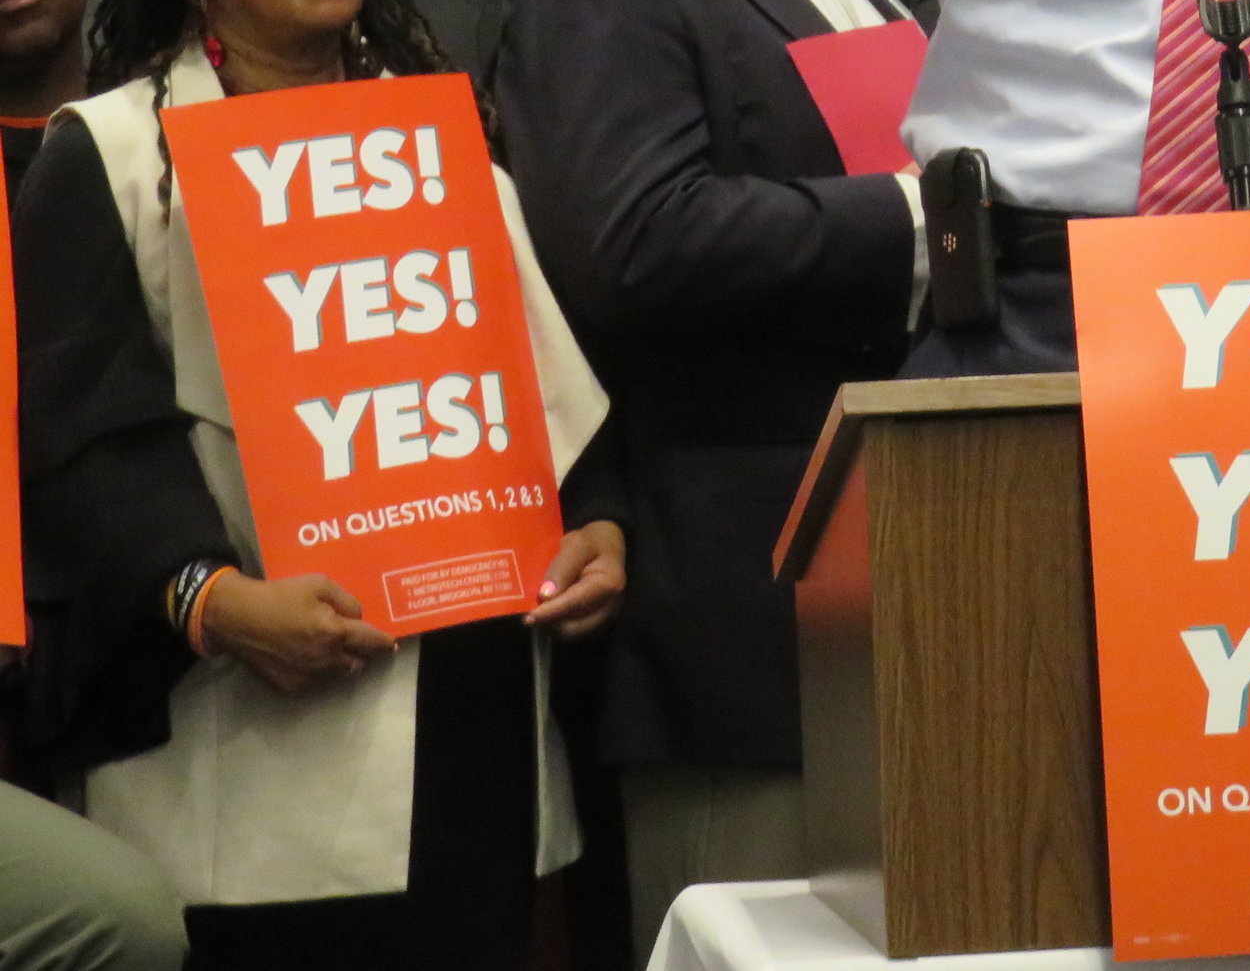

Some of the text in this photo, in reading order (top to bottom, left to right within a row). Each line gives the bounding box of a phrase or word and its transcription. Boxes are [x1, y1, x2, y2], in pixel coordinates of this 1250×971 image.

[232, 126, 446, 227] YES!
[264, 248, 478, 353] YES!
[294, 372, 509, 482] YES!
[298, 517, 341, 547] ON
[346, 490, 482, 536] QUESTIONS
[1158, 787, 1212, 817] ON
